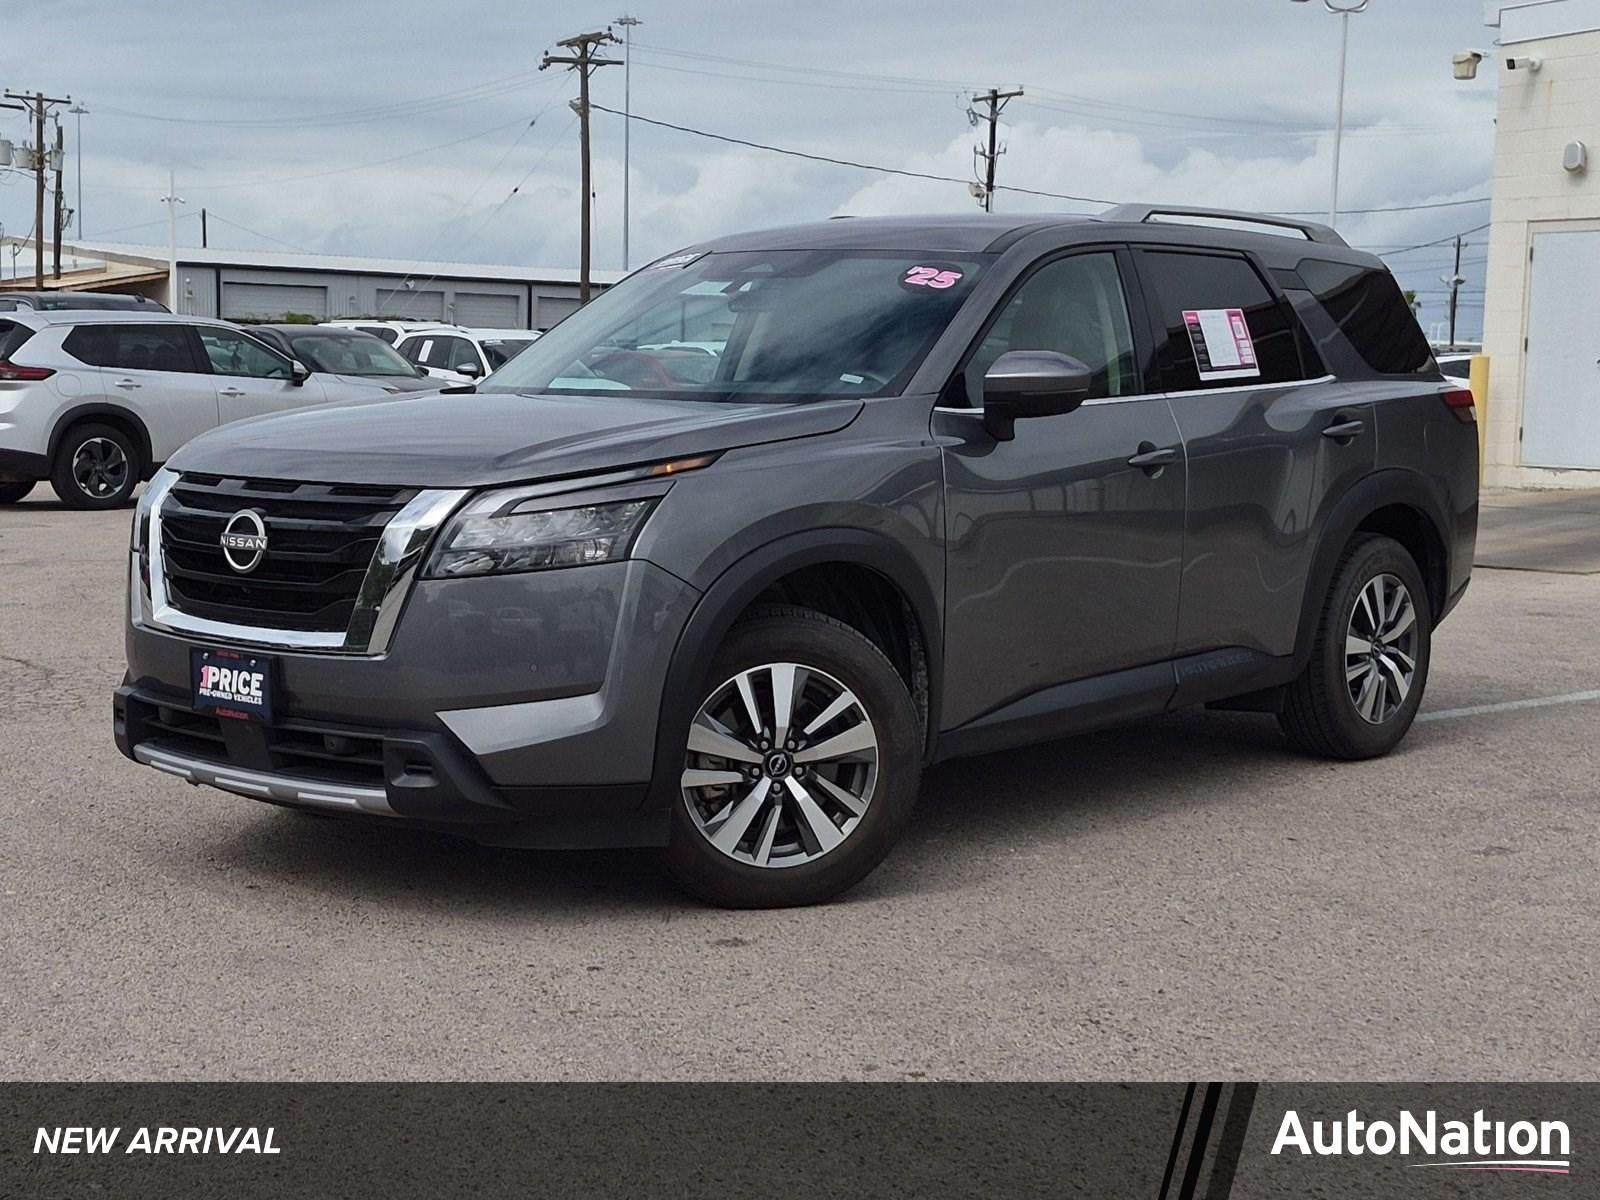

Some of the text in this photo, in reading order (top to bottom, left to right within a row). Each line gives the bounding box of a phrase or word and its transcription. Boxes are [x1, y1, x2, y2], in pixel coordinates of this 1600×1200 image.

[220, 535, 266, 549] NISSAN
[200, 665, 264, 697] 1PRICE
[233, 694, 262, 705] VEHICLES
